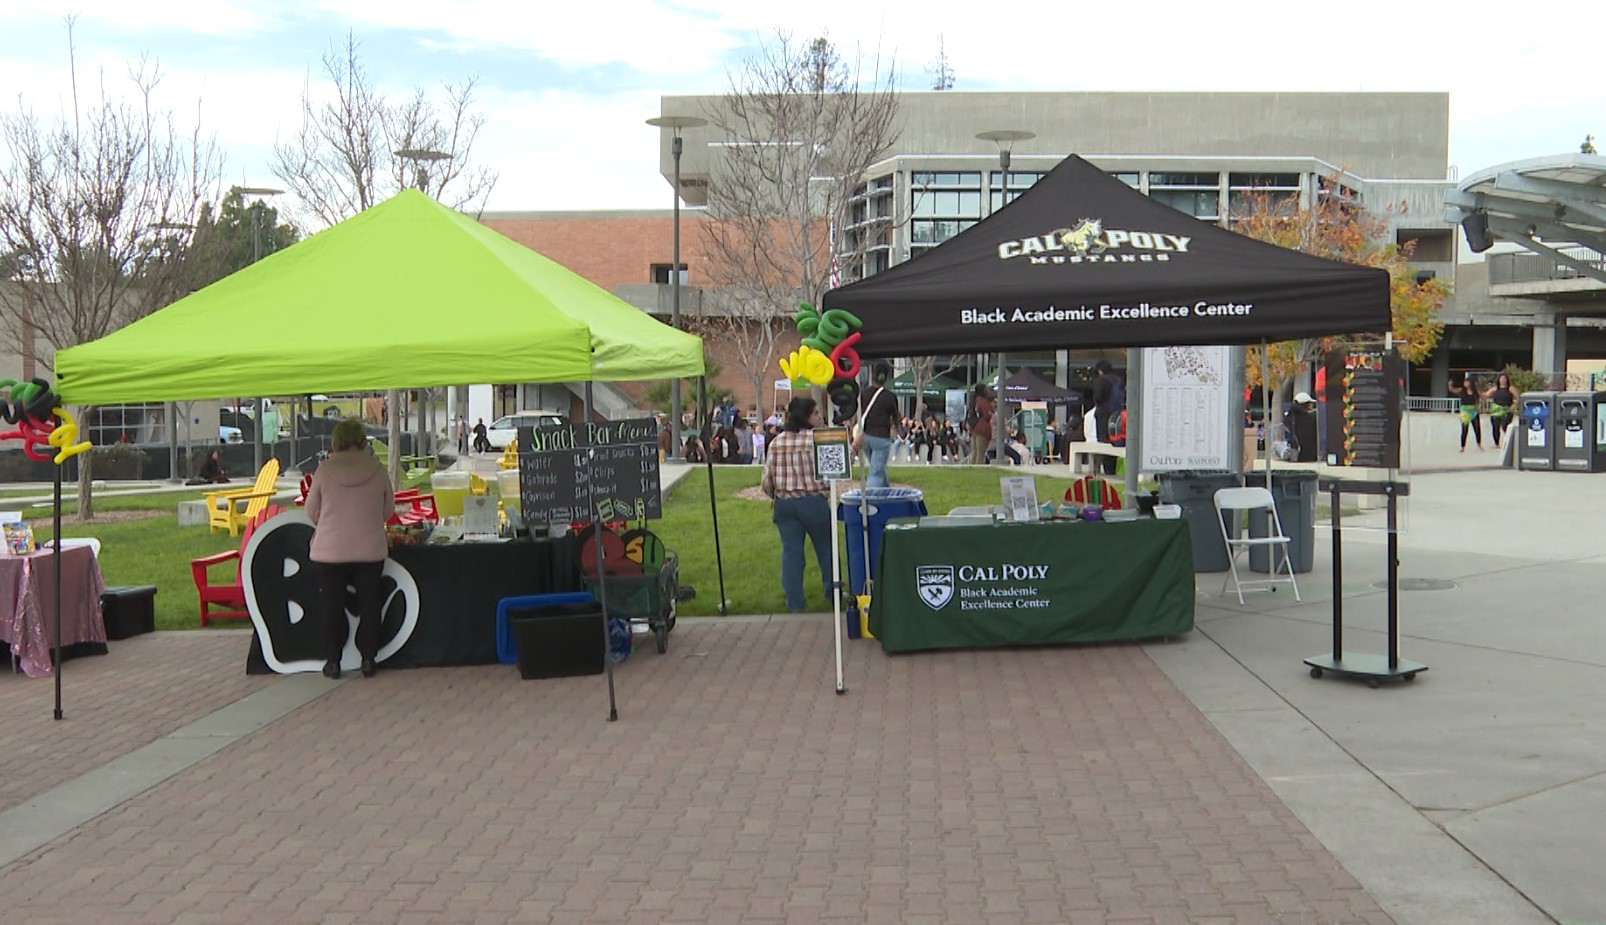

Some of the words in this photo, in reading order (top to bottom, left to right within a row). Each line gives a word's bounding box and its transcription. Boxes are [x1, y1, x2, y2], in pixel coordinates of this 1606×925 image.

[998, 234, 1064, 259] CAL
[1104, 229, 1192, 252] POLY
[1030, 253, 1170, 264] MUSTANGS
[961, 306, 1006, 325] Black
[1010, 305, 1095, 323] Academic
[1100, 303, 1190, 320] Excellence
[1194, 302, 1253, 317] Center
[531, 423, 578, 452] Snack
[585, 422, 612, 446] Bar
[614, 422, 656, 443] Menu
[960, 588, 987, 598] Black
[989, 586, 1038, 597] Academic
[961, 600, 1014, 610] Excellence
[1015, 599, 1051, 609] Center
